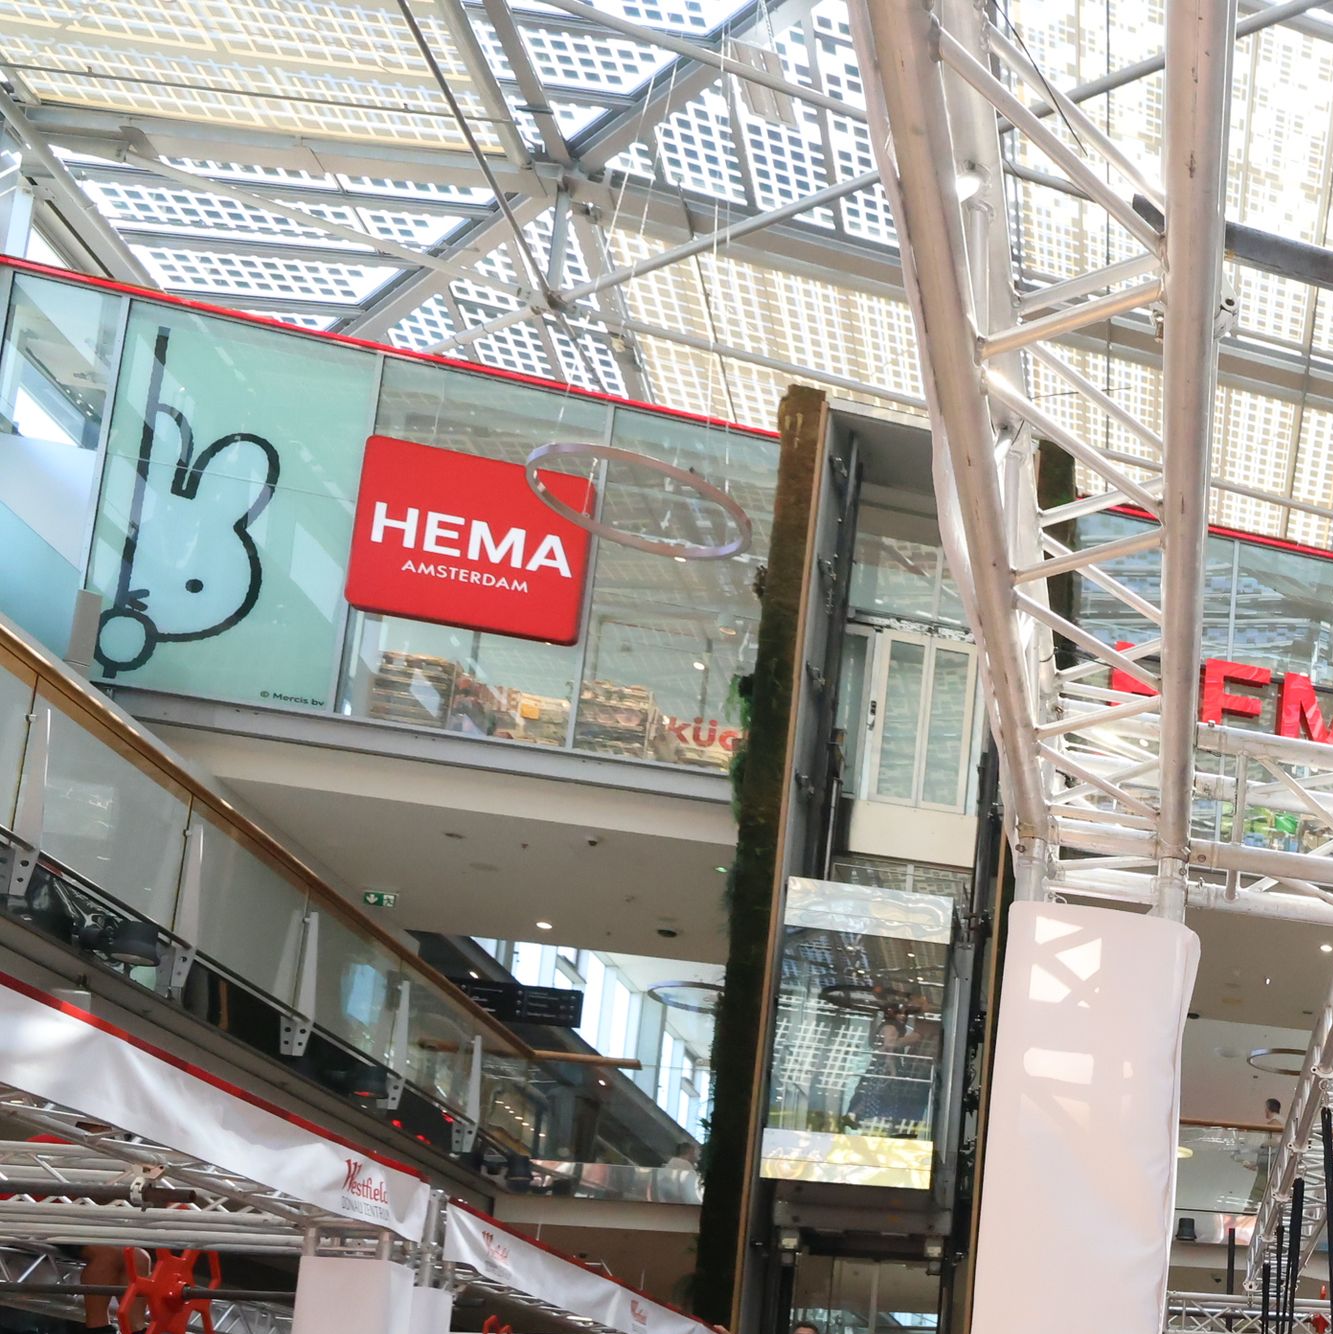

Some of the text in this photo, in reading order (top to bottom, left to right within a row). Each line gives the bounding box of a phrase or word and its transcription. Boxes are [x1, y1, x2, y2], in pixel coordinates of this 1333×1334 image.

[370, 501, 573, 578] HEMA
[401, 559, 528, 593] AMSTERDAM
[272, 692, 308, 704] Mercis
[311, 698, 325, 706] bv
[667, 716, 749, 751] küc
